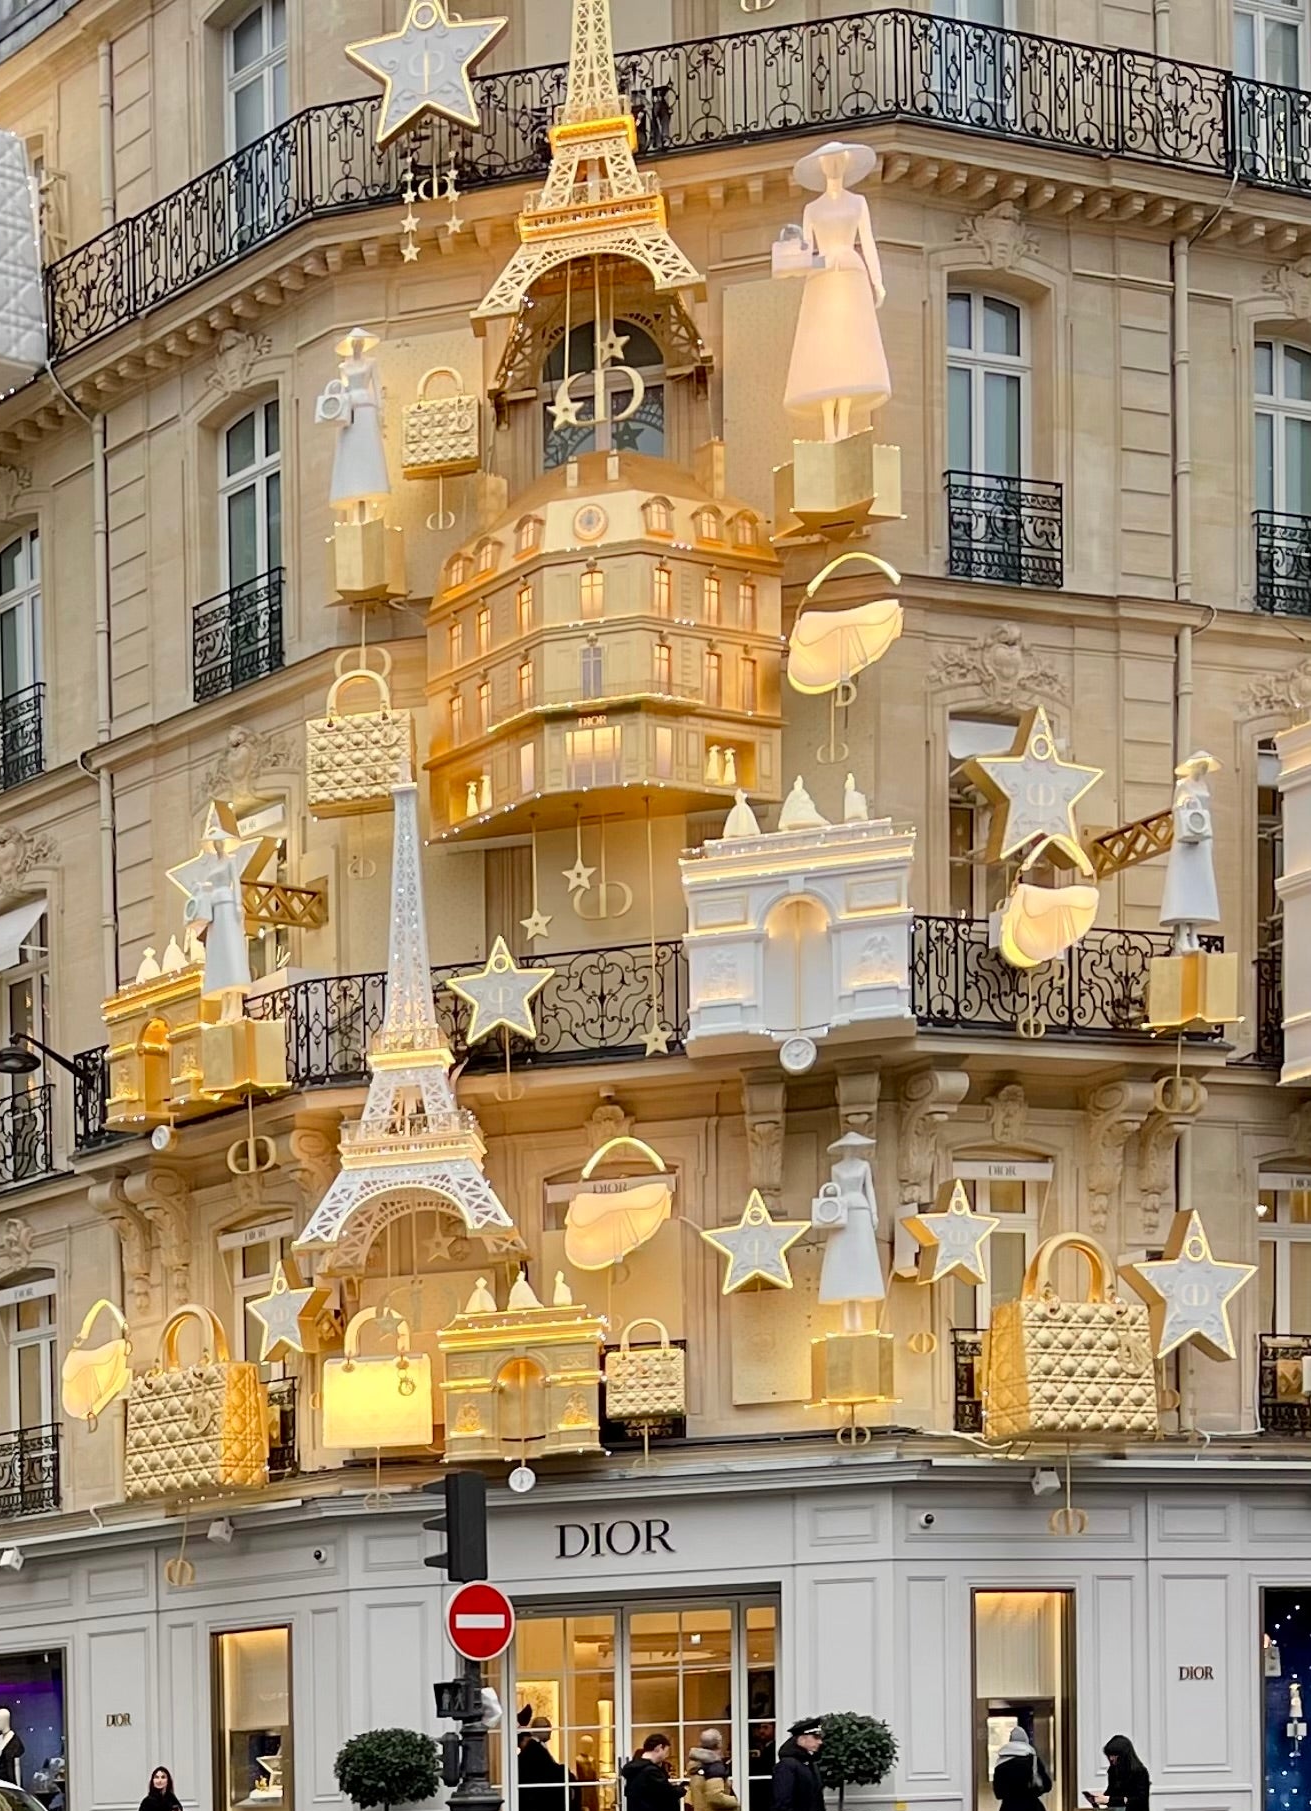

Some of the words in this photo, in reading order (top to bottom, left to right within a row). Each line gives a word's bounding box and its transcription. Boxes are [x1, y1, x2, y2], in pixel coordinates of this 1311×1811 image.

[578, 714, 608, 729] DIOR
[986, 1164, 1017, 1177] DIOR
[592, 1182, 628, 1195] DIOR
[554, 1518, 676, 1559] DIOR
[1178, 1665, 1214, 1682] DIOR
[105, 1712, 132, 1728] DIOR
